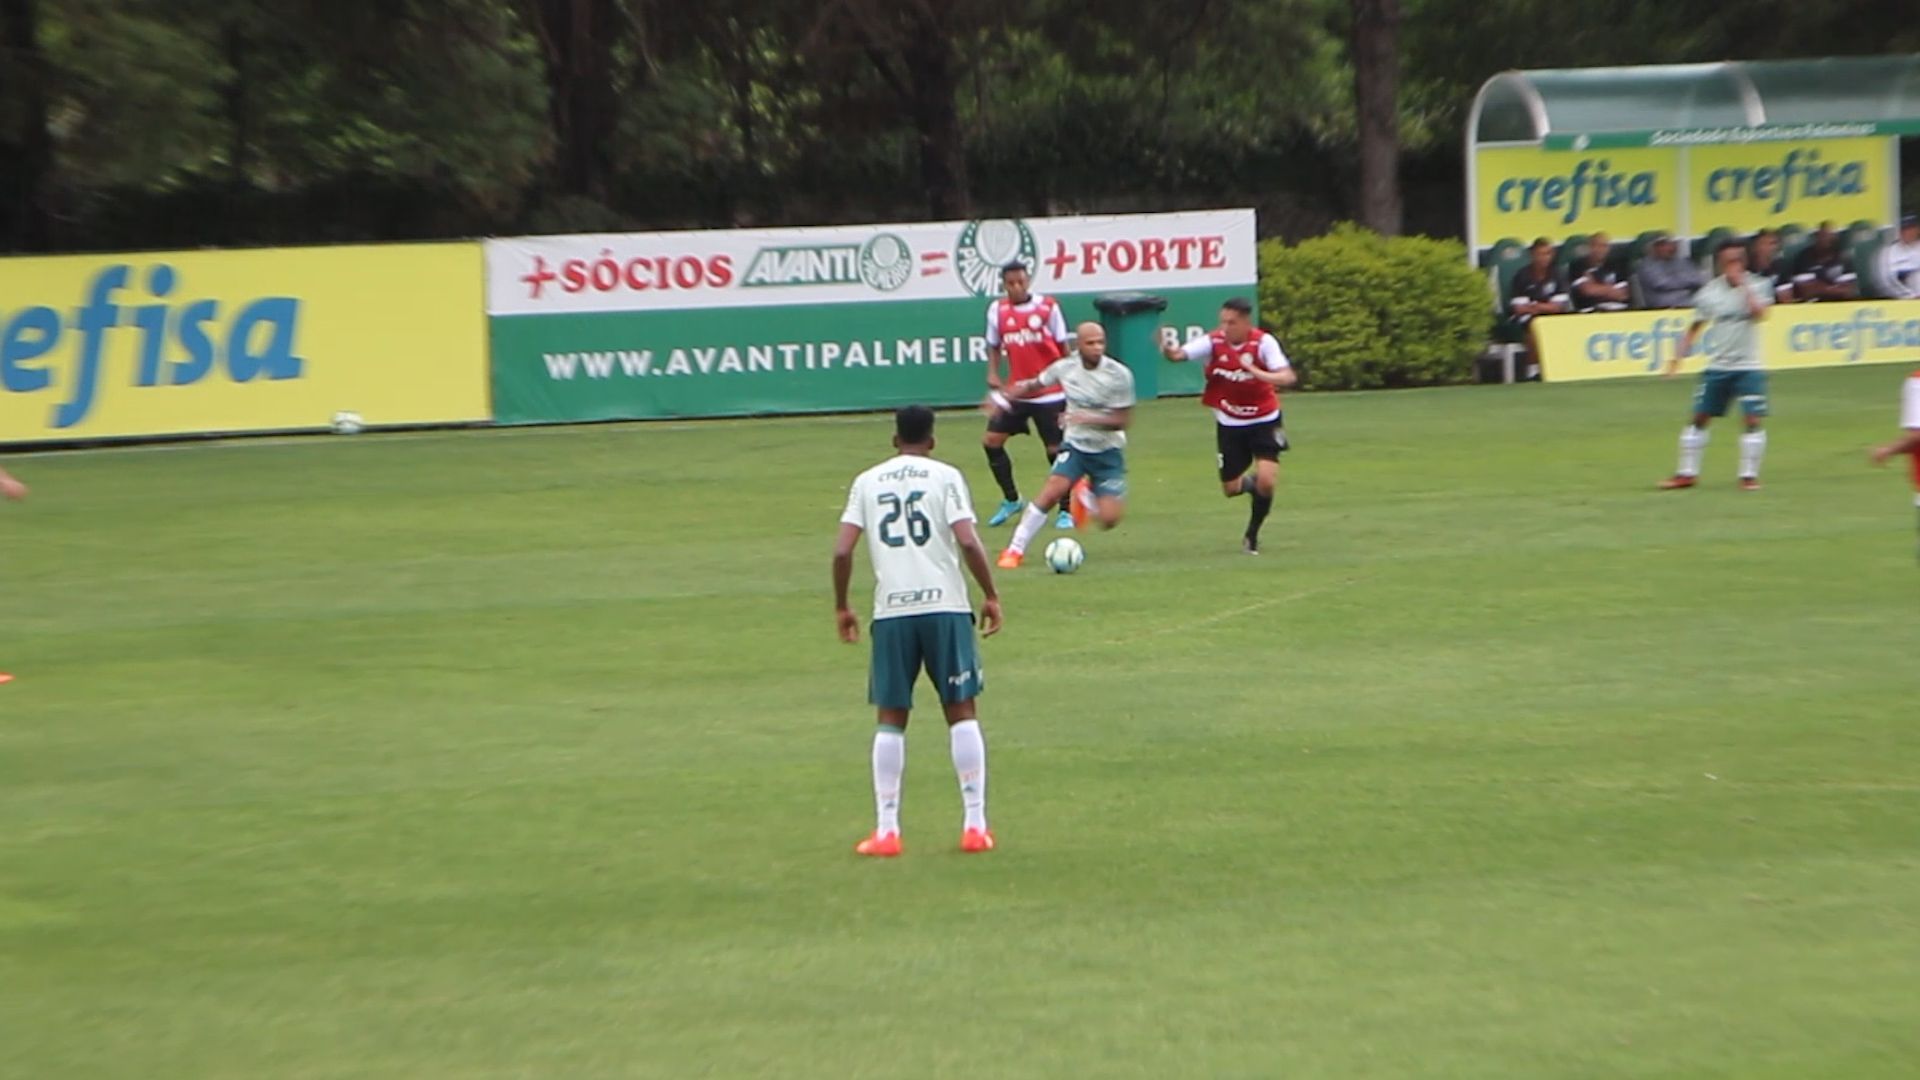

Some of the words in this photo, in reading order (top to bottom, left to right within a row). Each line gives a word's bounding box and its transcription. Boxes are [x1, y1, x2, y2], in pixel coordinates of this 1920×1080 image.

[1496, 160, 1658, 224] crefisa
[1705, 148, 1867, 214] crefisa
[746, 247, 858, 284] AVANTI
[878, 465, 929, 482] crefisa
[877, 491, 931, 547] 26
